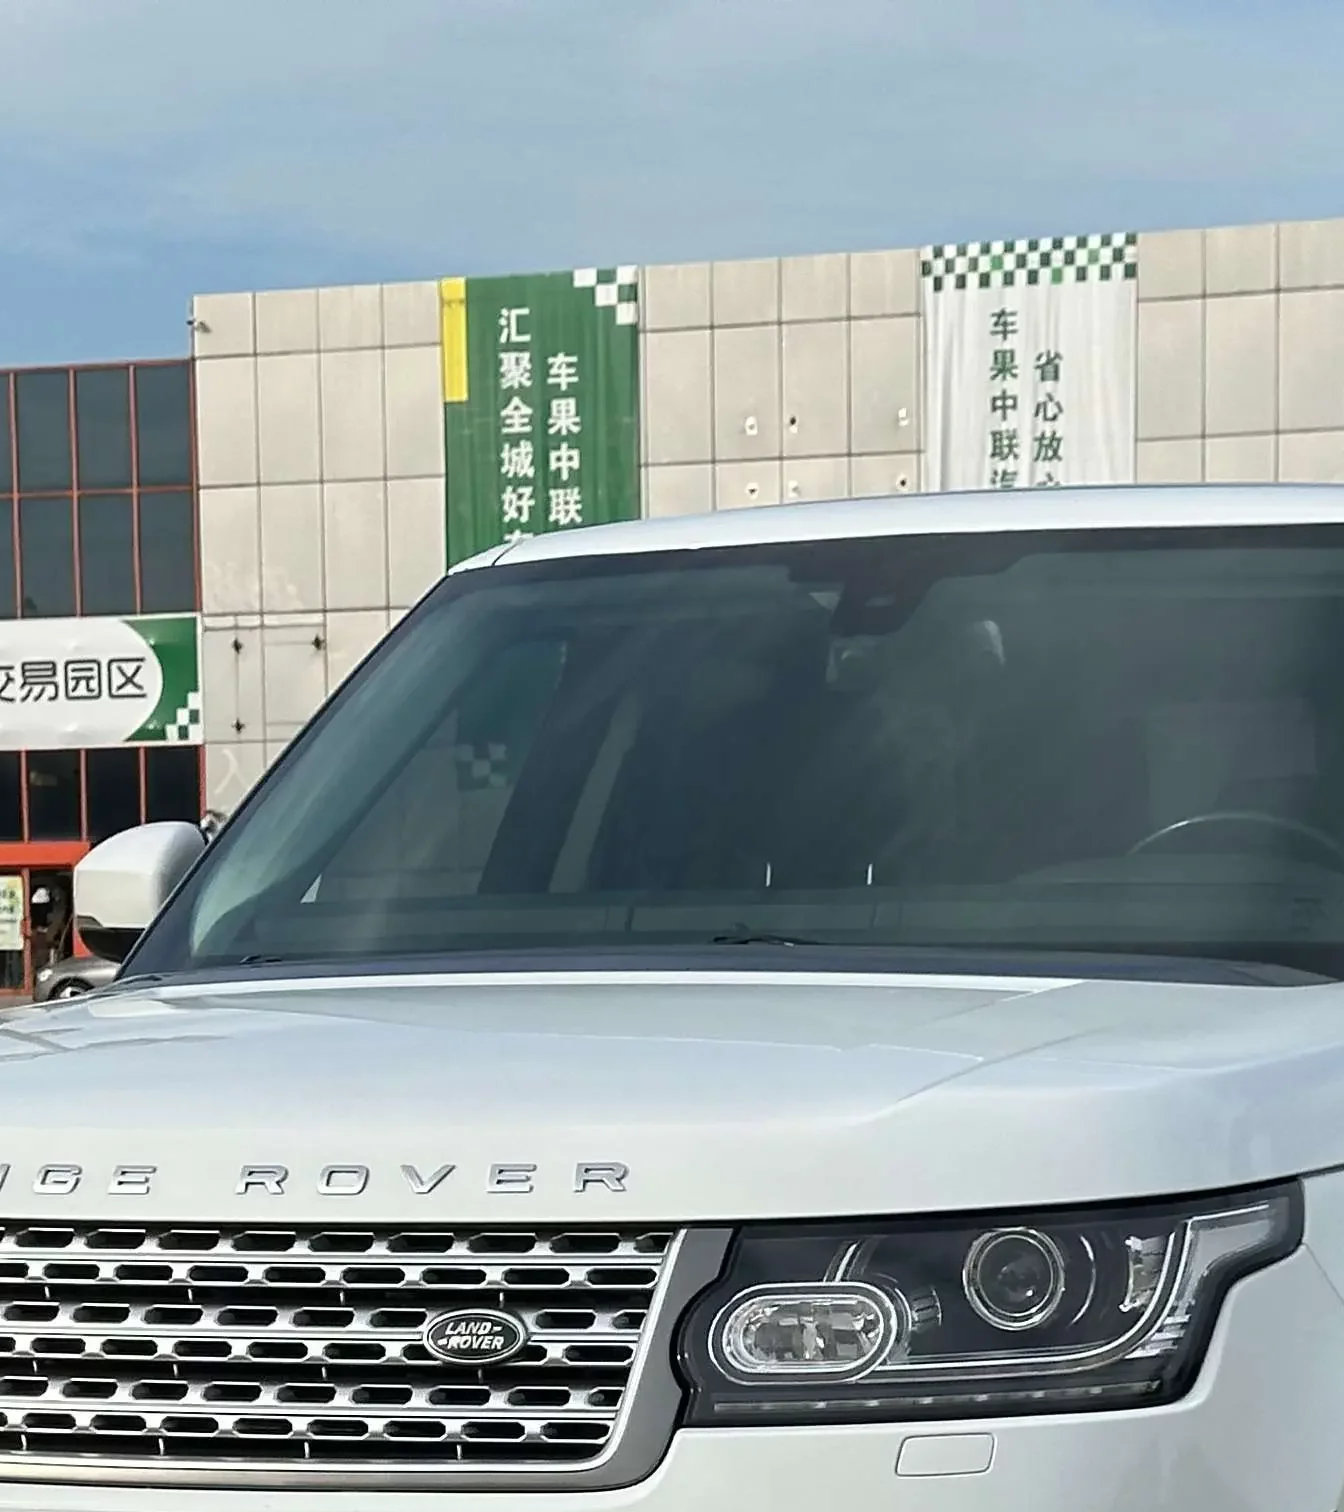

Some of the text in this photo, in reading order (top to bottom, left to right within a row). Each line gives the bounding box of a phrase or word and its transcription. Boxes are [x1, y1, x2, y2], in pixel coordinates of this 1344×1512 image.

[547, 352, 583, 525] 车果中联
[233, 1160, 631, 1196] ROVER
[444, 1321, 493, 1336] LAND
[445, 1334, 505, 1350] ROVER
